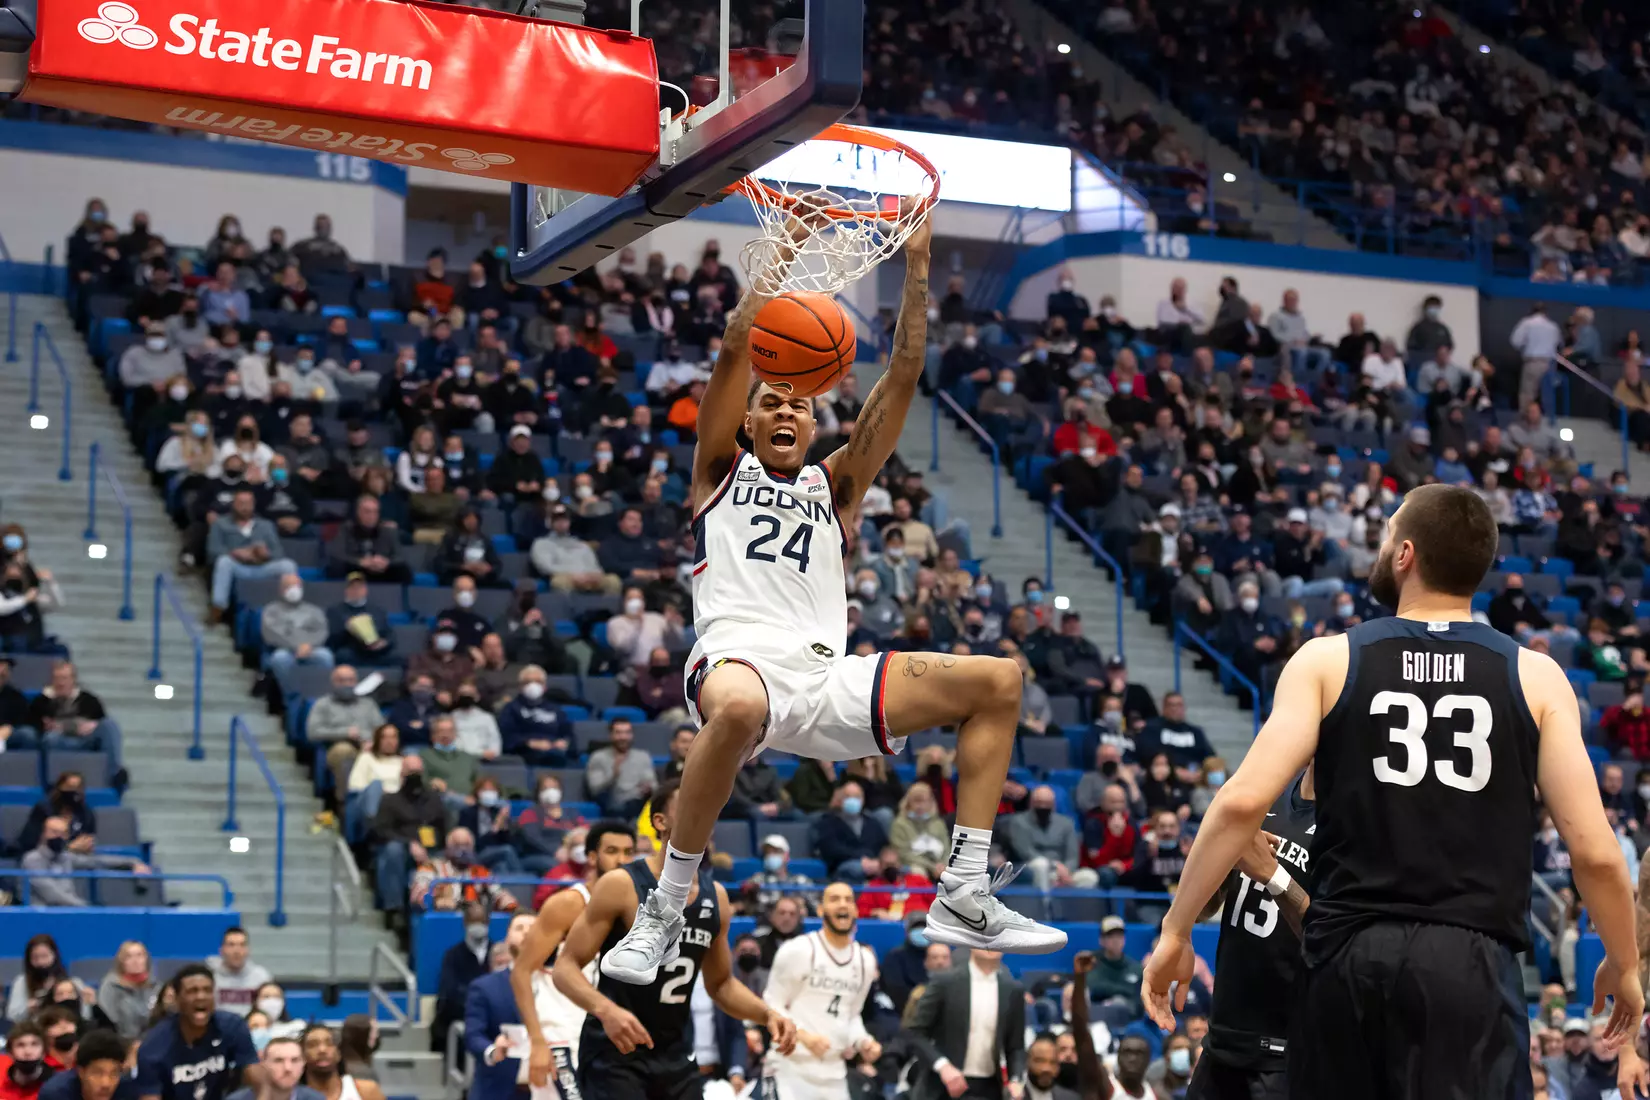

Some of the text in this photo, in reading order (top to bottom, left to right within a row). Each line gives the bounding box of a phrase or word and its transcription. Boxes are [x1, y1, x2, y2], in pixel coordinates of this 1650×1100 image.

[316, 152, 371, 180] 115
[1143, 233, 1190, 259] 116
[751, 342, 778, 360] UCONN
[733, 486, 832, 525] UCONN
[746, 514, 814, 573] 24
[1402, 650, 1465, 683] GOLDEN
[1369, 690, 1493, 792] 33
[1230, 871, 1280, 939] 13
[659, 957, 695, 1004] 2
[827, 995, 842, 1018] 4
